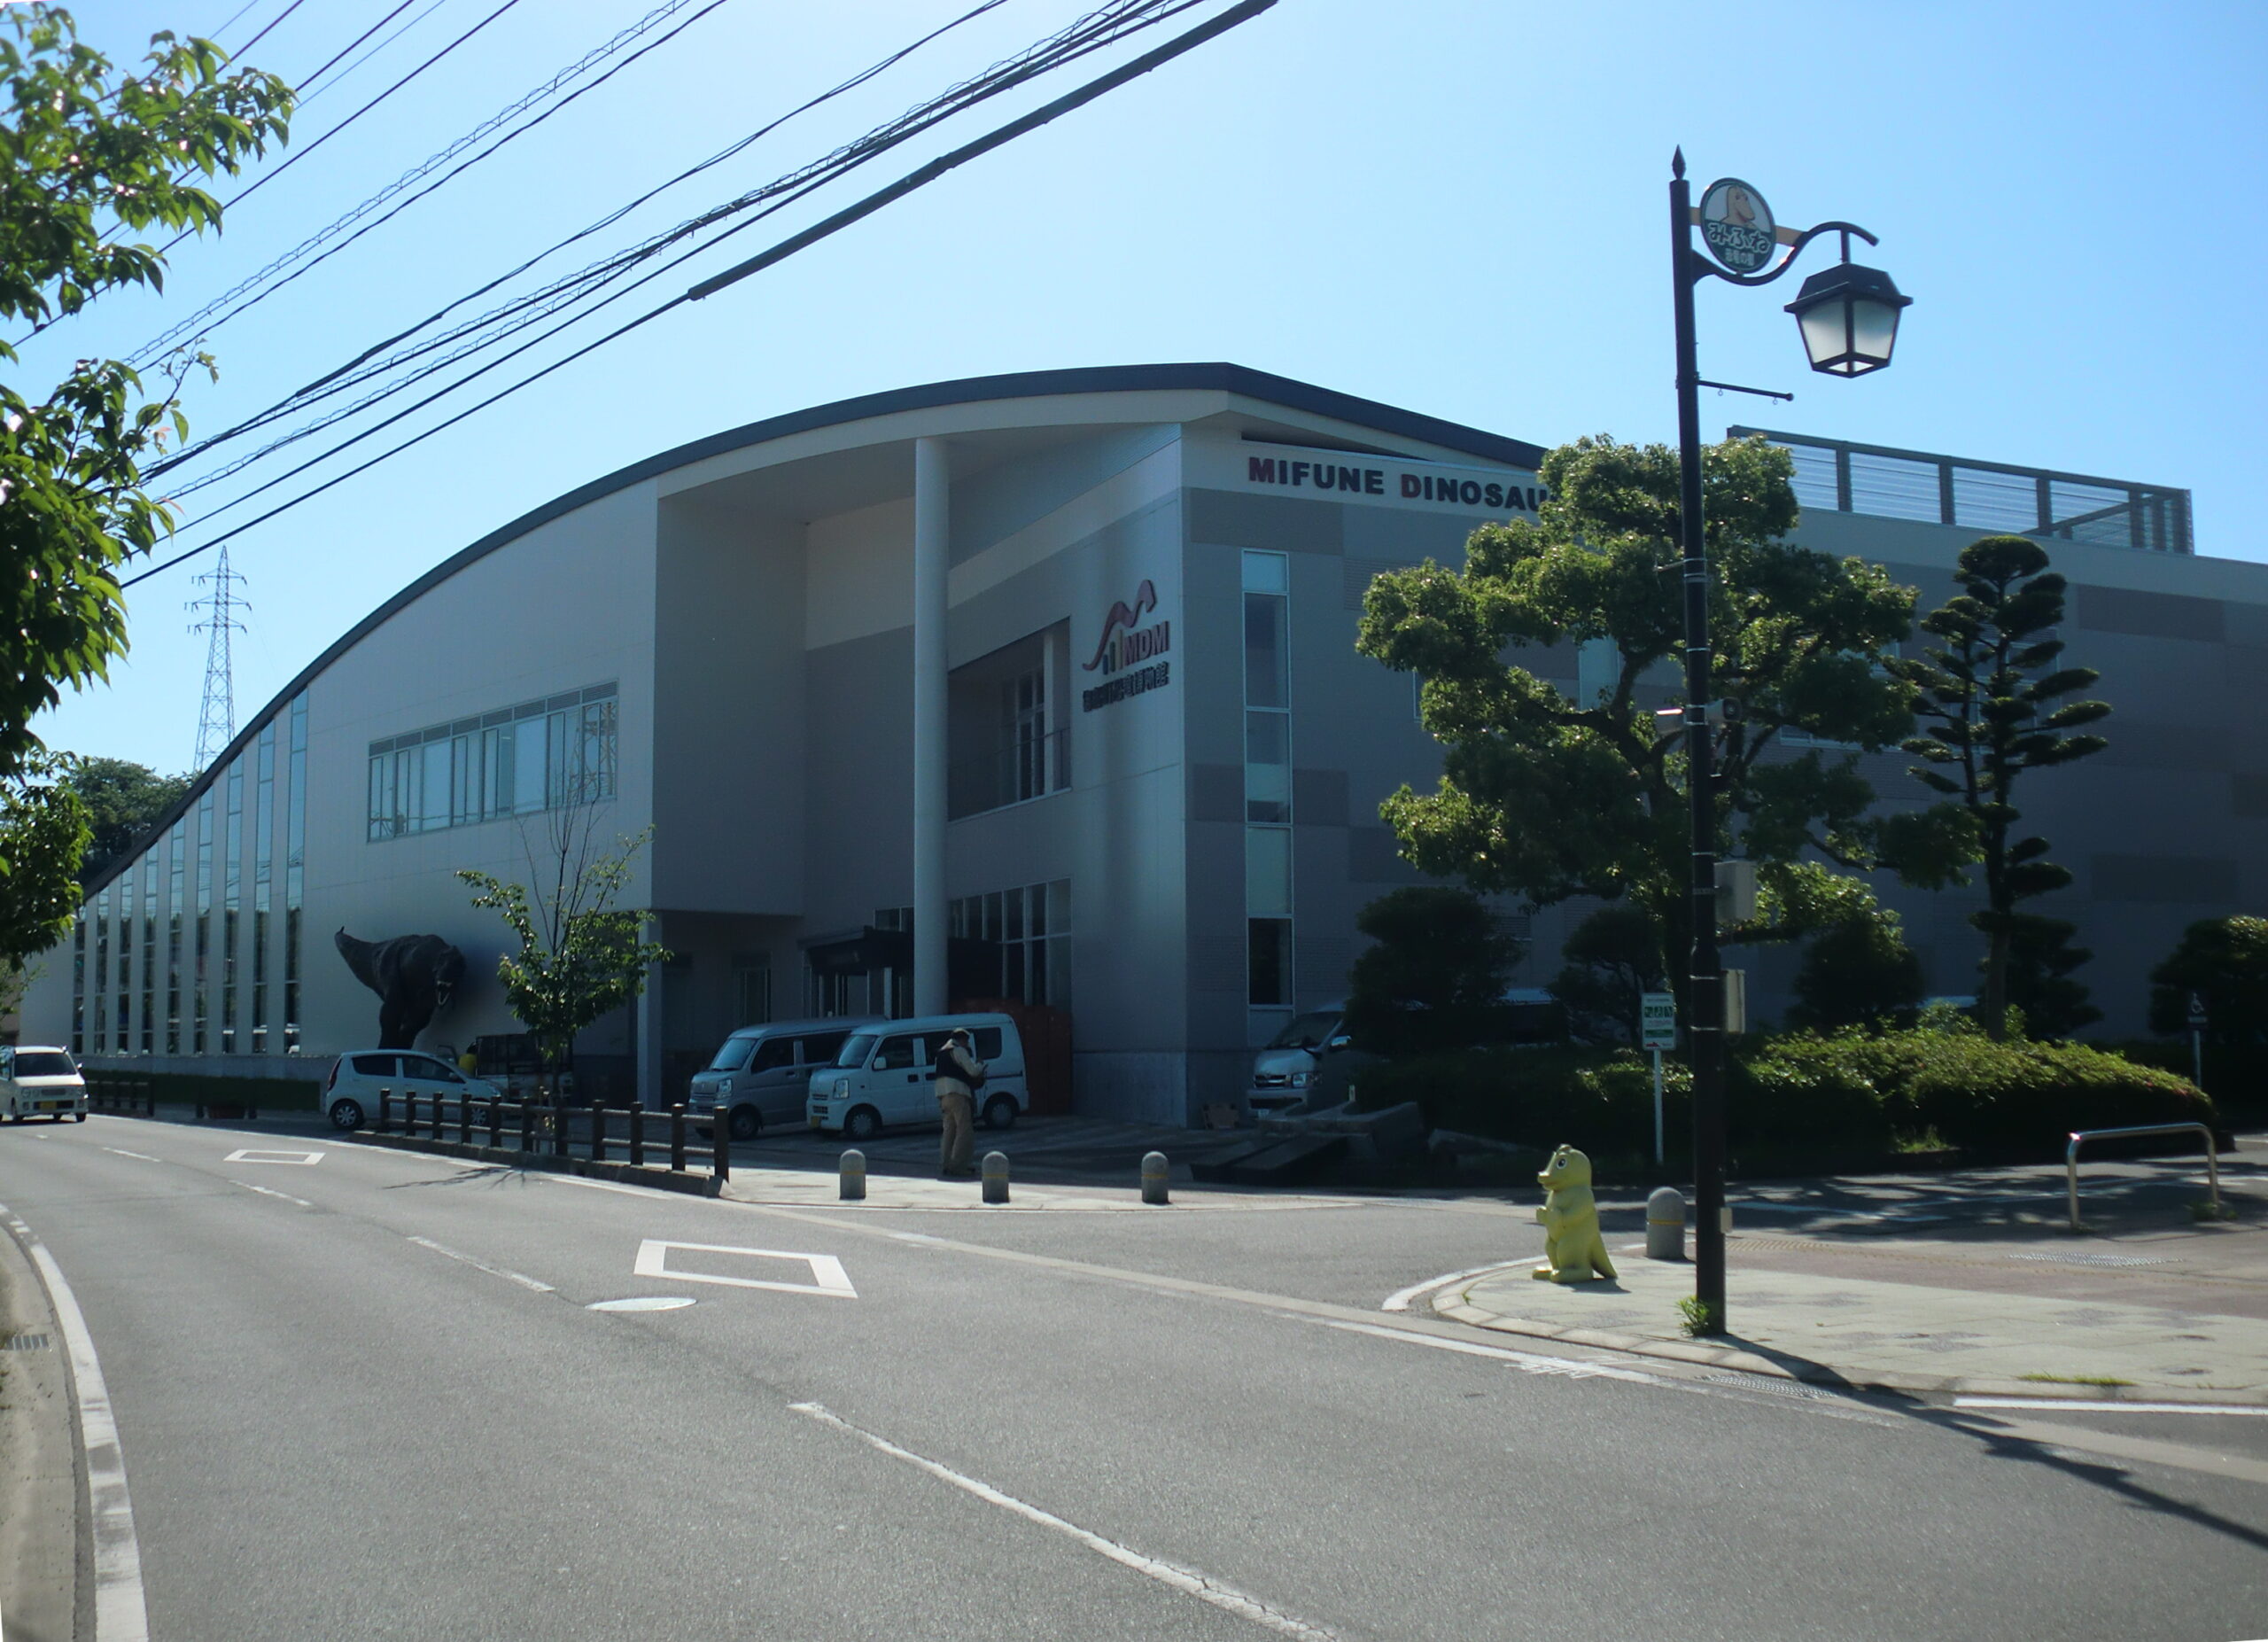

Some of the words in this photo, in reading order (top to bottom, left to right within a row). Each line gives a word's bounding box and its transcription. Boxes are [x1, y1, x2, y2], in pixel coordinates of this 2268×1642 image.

[1707, 221, 1771, 254] みふね
[1248, 456, 1385, 495] MIFUNE
[1401, 473, 1559, 512] DINOSAU
[1123, 620, 1170, 667] MDM
